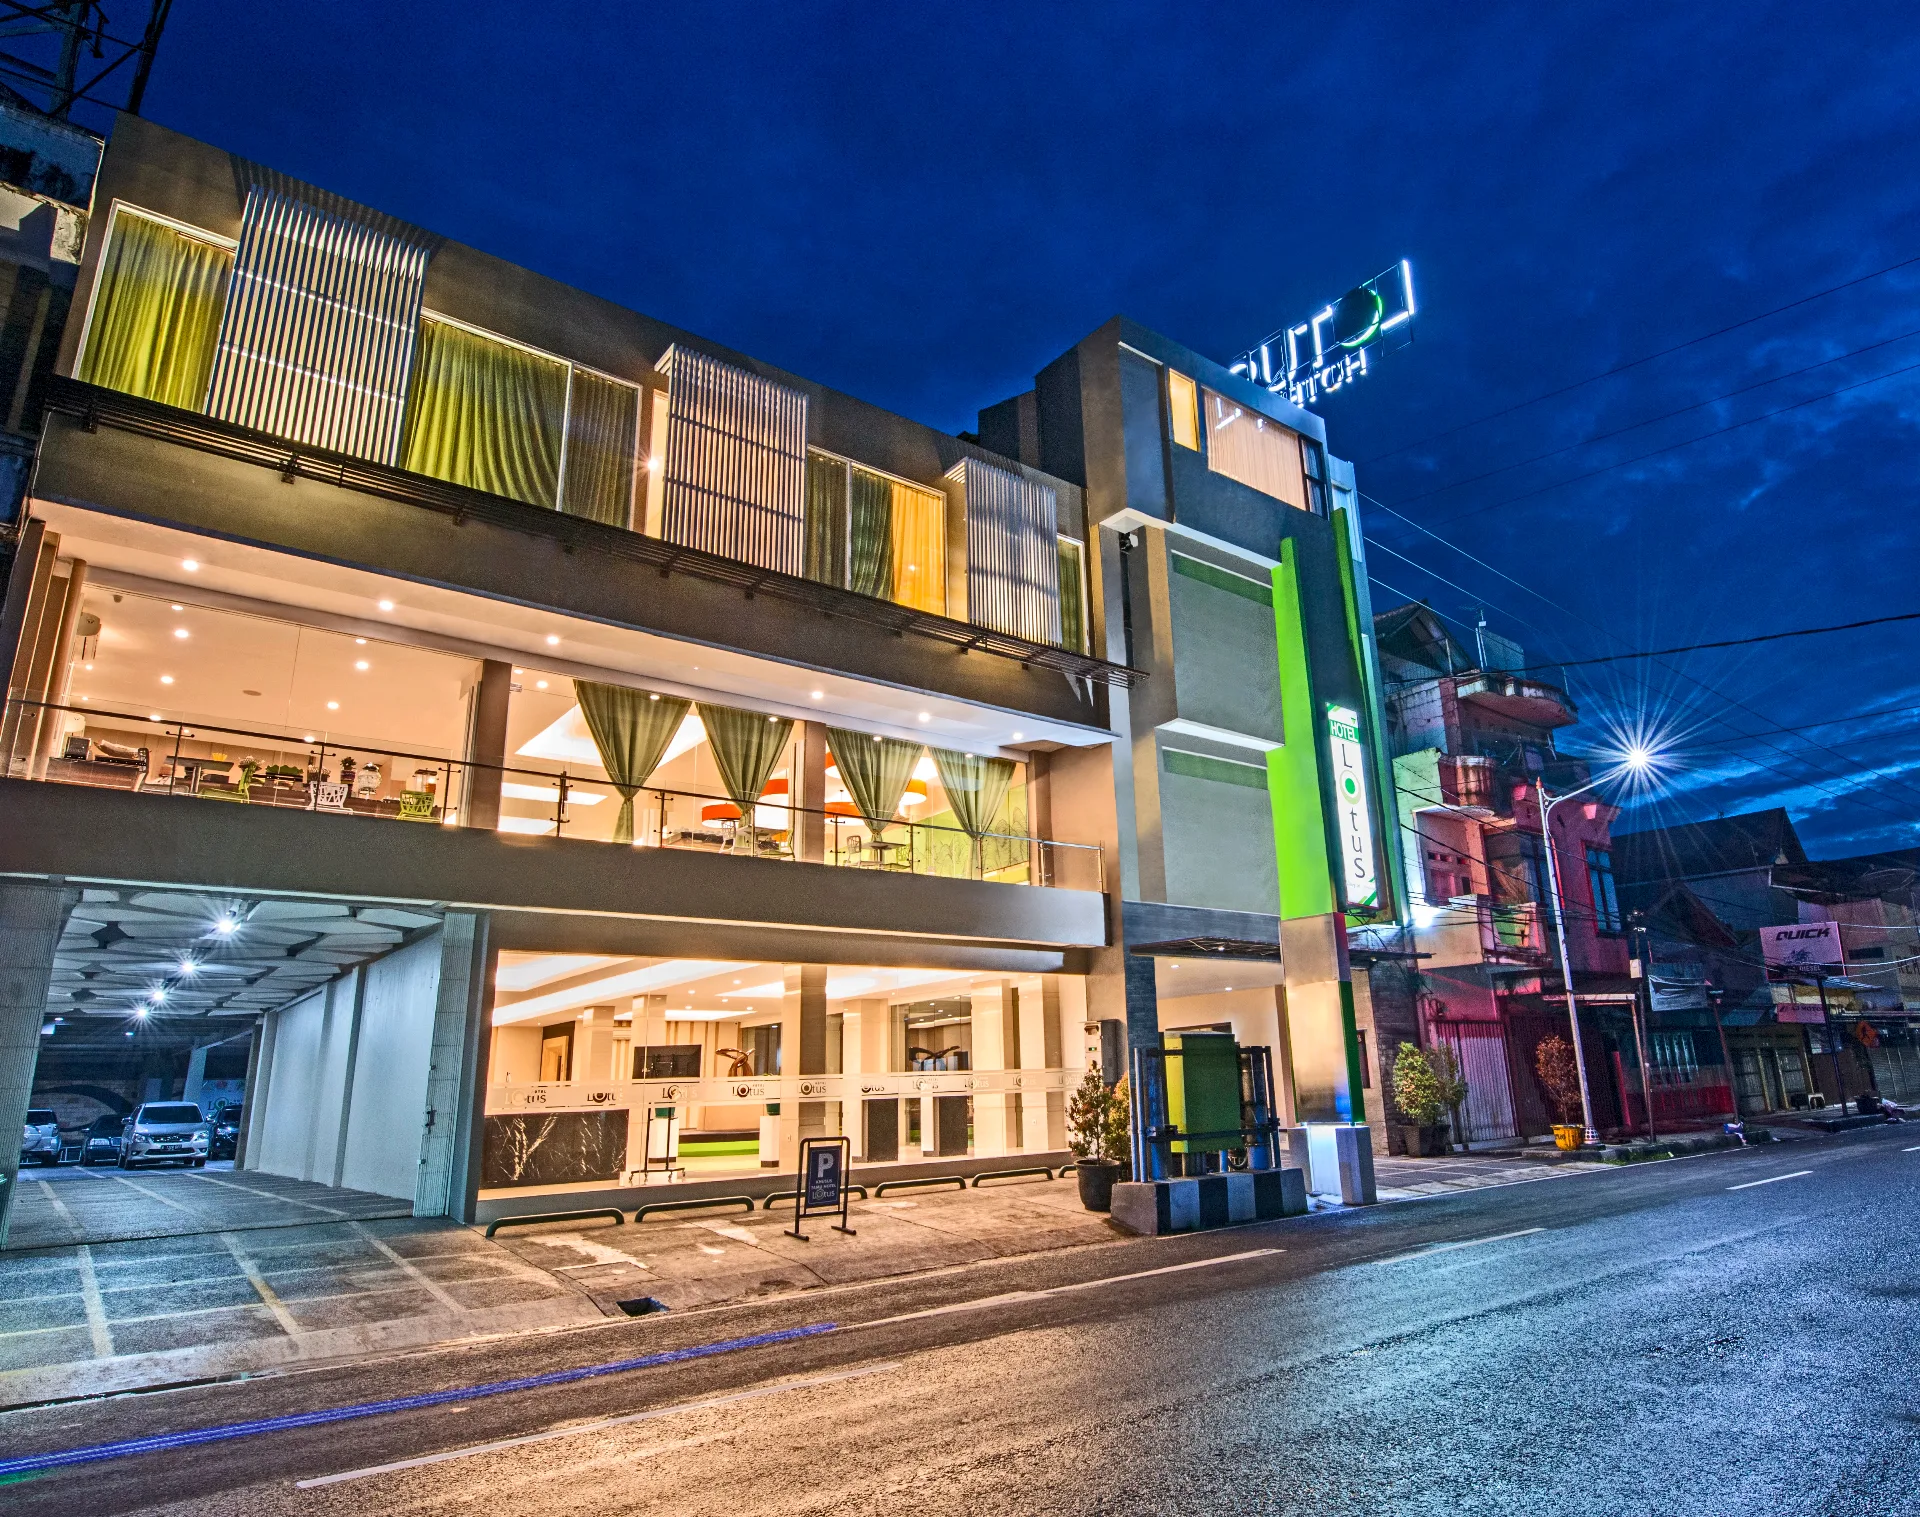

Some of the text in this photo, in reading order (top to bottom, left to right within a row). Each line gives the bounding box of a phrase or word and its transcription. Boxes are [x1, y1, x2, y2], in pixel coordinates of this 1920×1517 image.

[1330, 720, 1359, 743] HOTEL
[1775, 927, 1831, 941] QUICK
[818, 1153, 834, 1178] P
